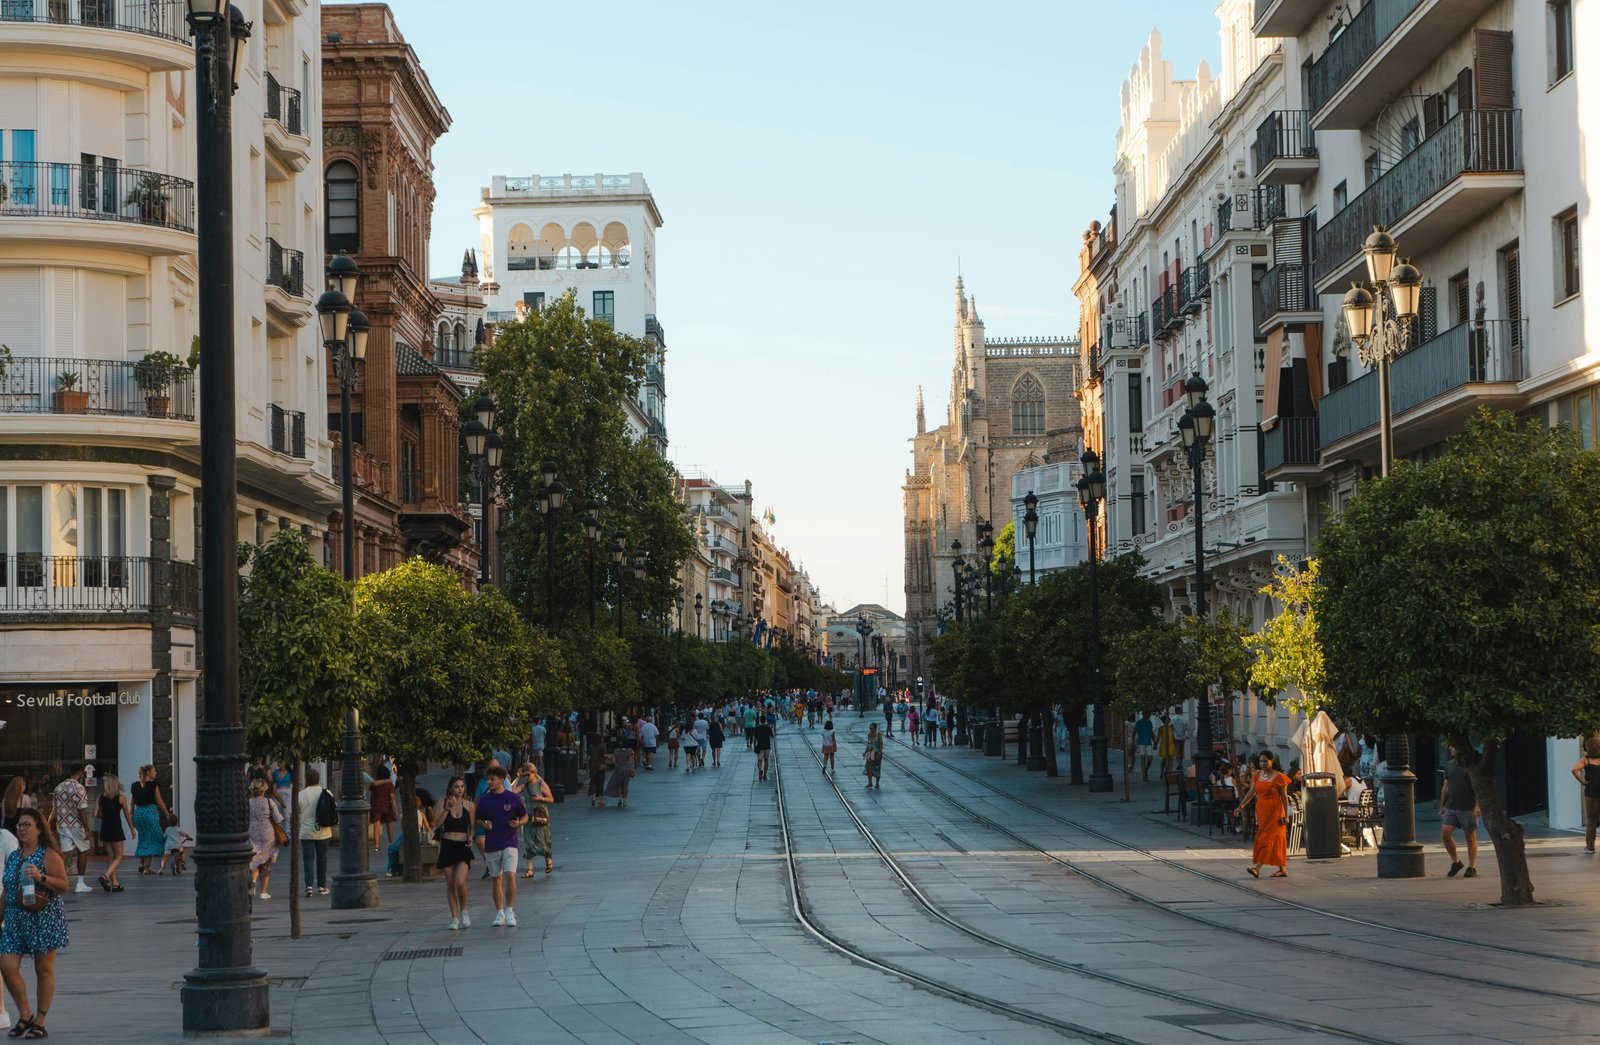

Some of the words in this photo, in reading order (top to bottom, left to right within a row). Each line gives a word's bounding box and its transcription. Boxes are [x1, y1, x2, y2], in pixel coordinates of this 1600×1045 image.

[17, 693, 63, 707] Sevilla
[67, 692, 116, 706] Football
[119, 691, 140, 705] Club
